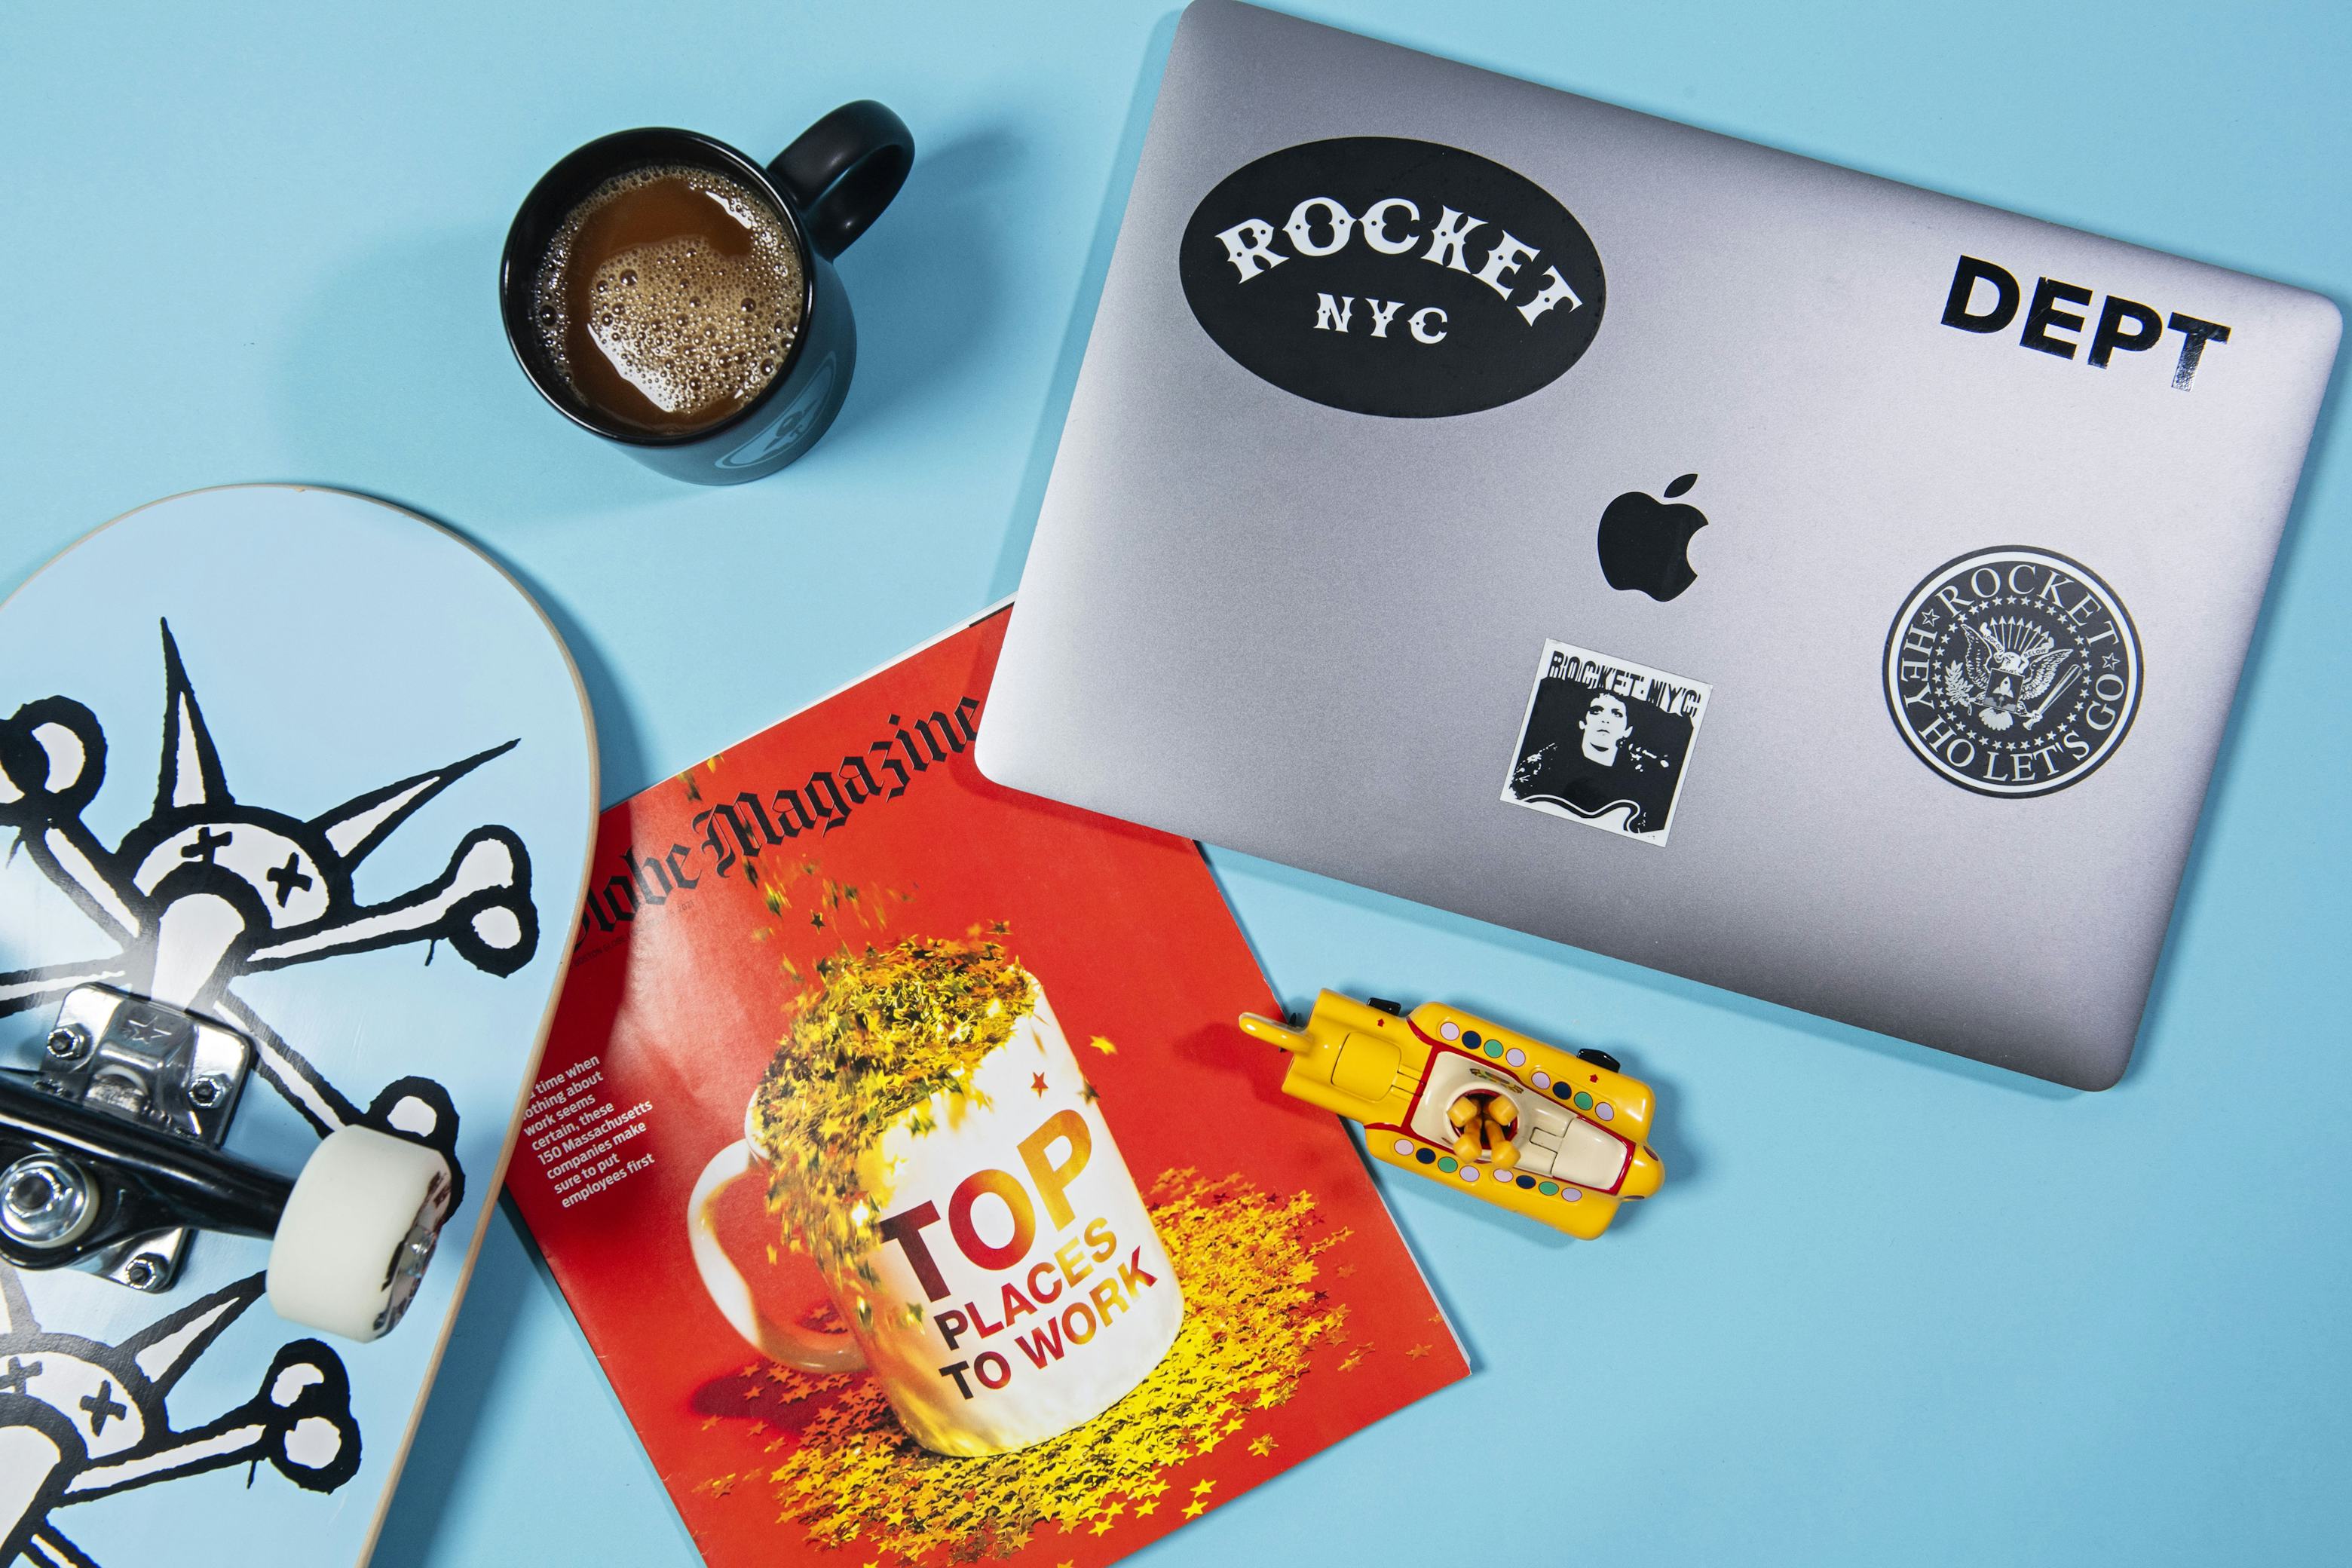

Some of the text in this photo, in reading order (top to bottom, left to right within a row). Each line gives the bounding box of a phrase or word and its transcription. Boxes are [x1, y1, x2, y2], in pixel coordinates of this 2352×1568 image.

[1214, 196, 1584, 326] ROCKET
[1313, 292, 1448, 345] NYC
[1940, 254, 2232, 393] DEPT
[1934, 564, 2120, 648] ROCKET
[1548, 651, 1701, 718] ROCKET NYC
[2023, 648, 2047, 658] BELOW
[1900, 623, 2124, 782] HEY HO LET'S GO
[574, 695, 980, 953] lobe Magazine
[524, 1070, 604, 1121] othing about
[535, 1055, 600, 1094] time when
[523, 1094, 596, 1137] work seems
[531, 1102, 615, 1151] certain, these
[537, 1100, 654, 1165] 150 Massachusetts
[546, 1122, 647, 1180] companies make
[553, 1153, 620, 1194] sure to put
[562, 1153, 655, 1208] employees first
[878, 1109, 1092, 1303] TOP
[933, 1217, 1117, 1351] PLACES
[939, 1245, 1158, 1400] TO WORK
